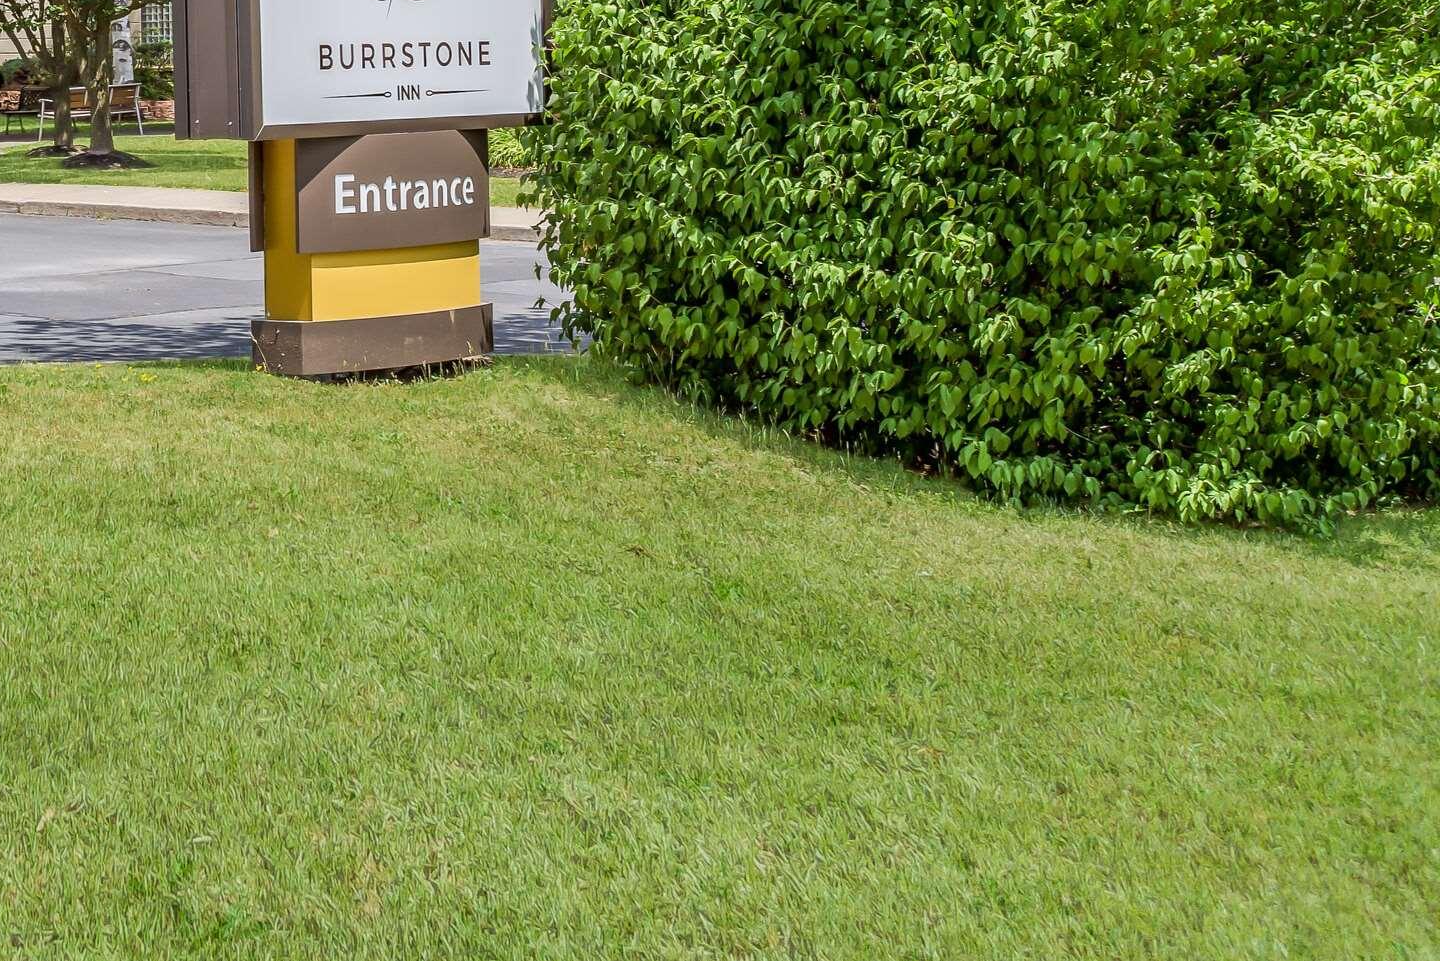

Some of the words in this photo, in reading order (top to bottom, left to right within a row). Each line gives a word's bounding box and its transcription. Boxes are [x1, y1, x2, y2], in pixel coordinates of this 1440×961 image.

[320, 41, 491, 70] BURRSTONE
[396, 85, 421, 101] INN
[334, 174, 474, 214] Entrance
